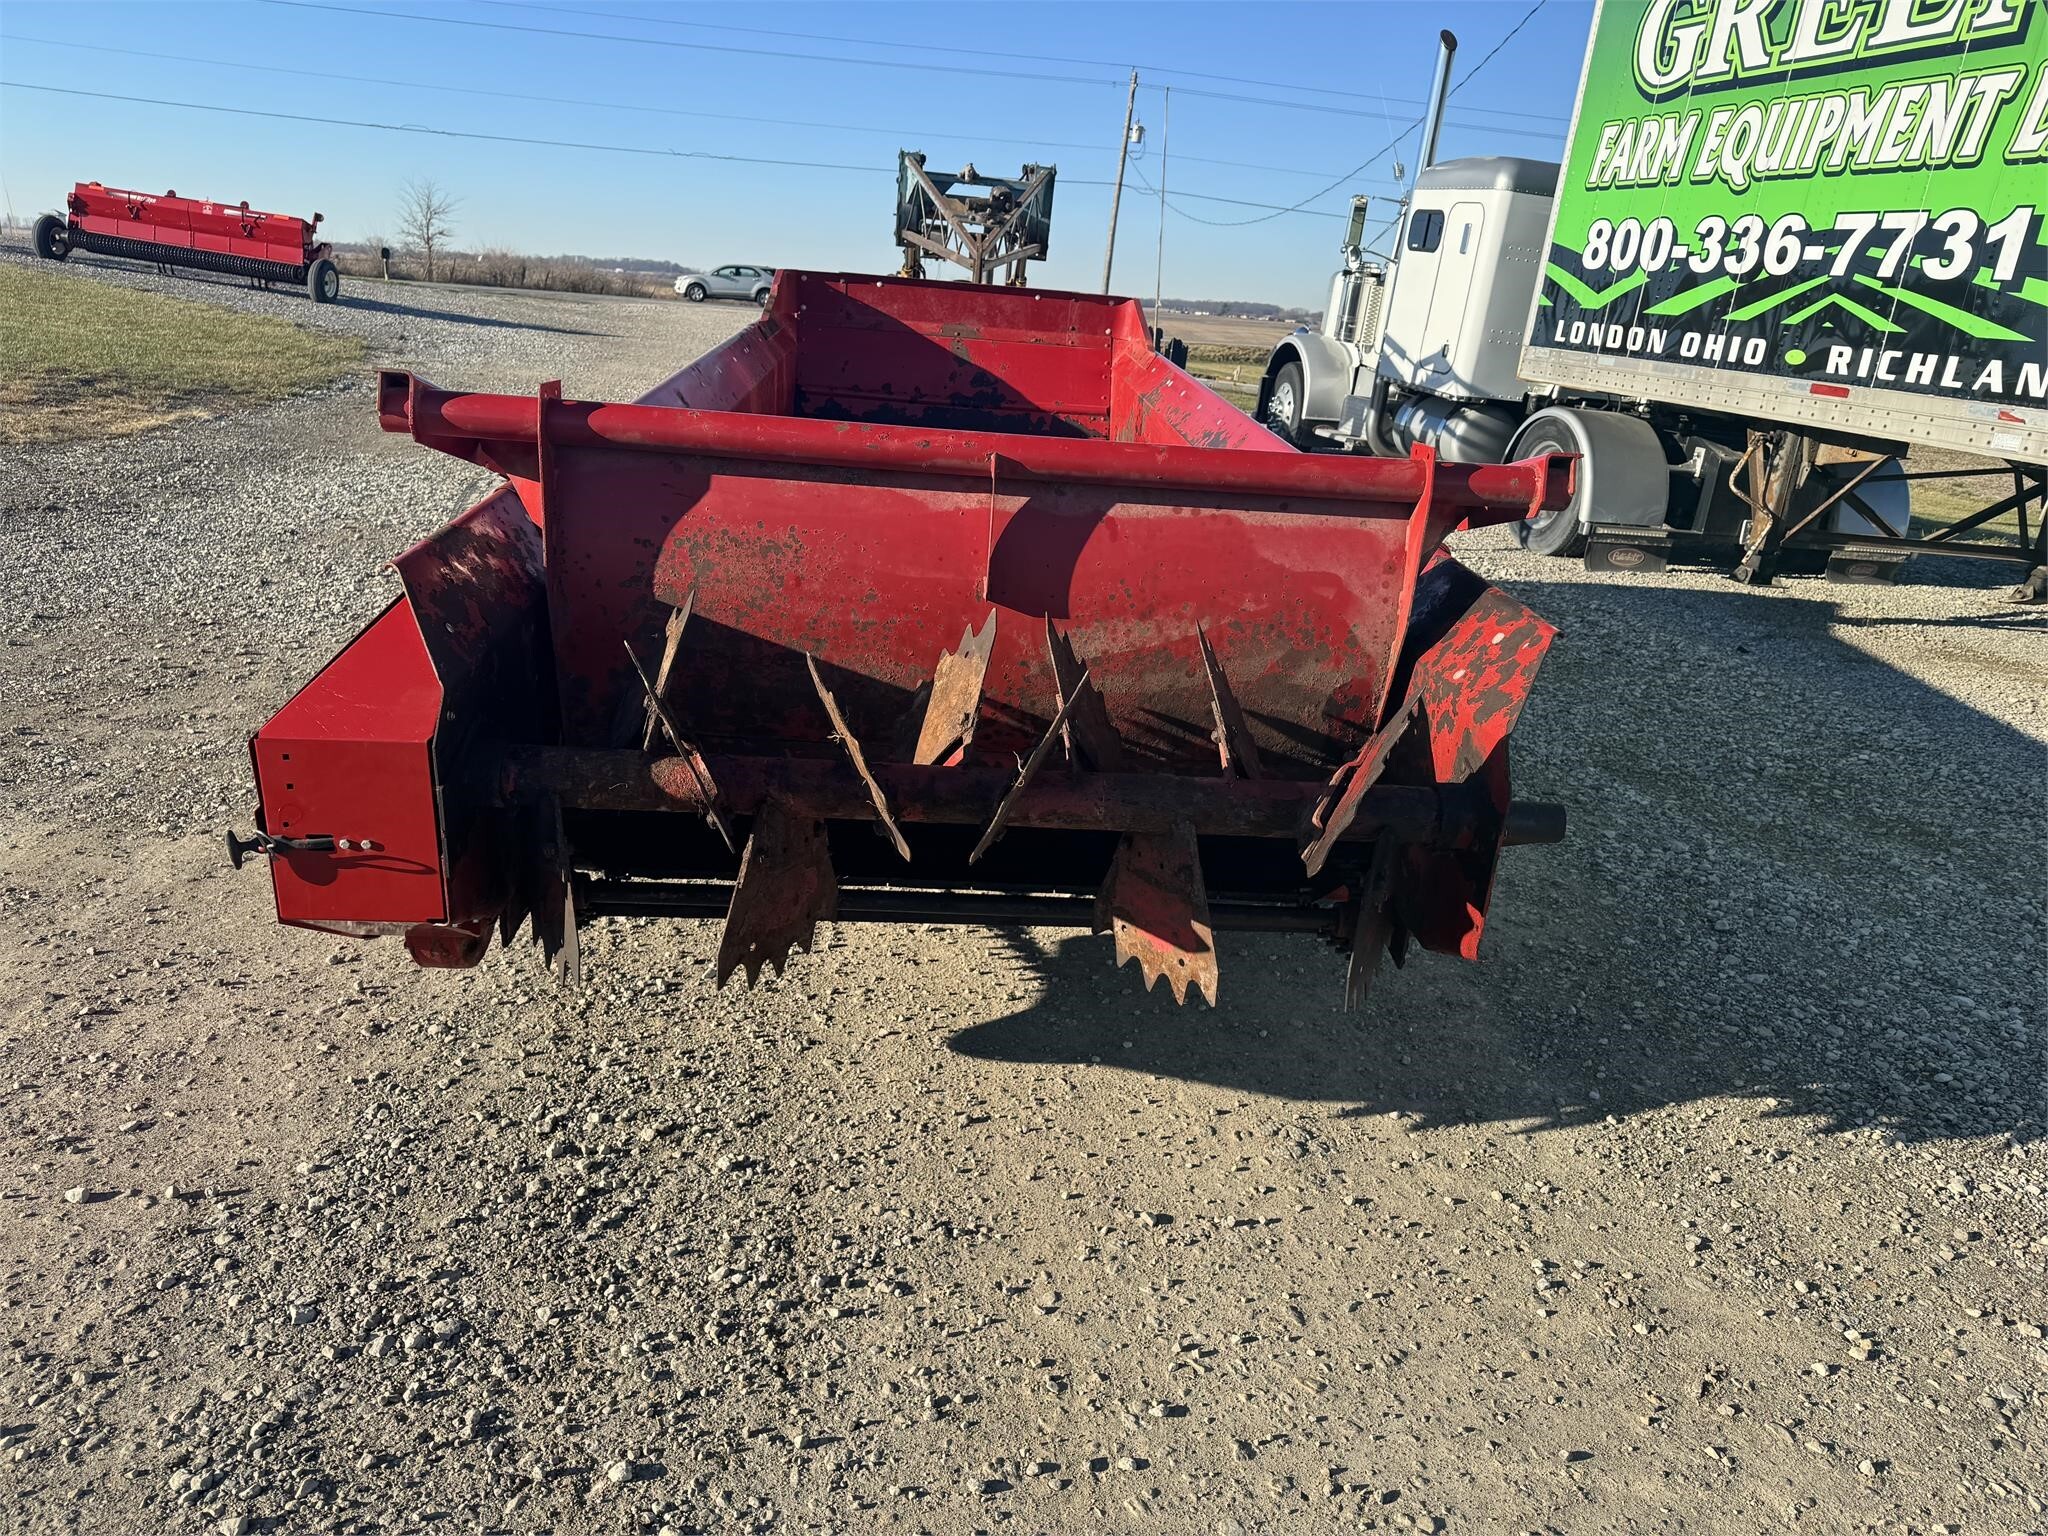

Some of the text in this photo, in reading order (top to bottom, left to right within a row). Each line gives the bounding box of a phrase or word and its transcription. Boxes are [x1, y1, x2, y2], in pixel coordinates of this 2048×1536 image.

[1636, 0, 2022, 87] GRE
[1587, 112, 1699, 185] FARM
[1700, 69, 2021, 187] EQUIPMENT
[1581, 206, 2034, 282] 800-336-7731
[1554, 319, 2048, 398] LONDON OHIO RICHLAN
